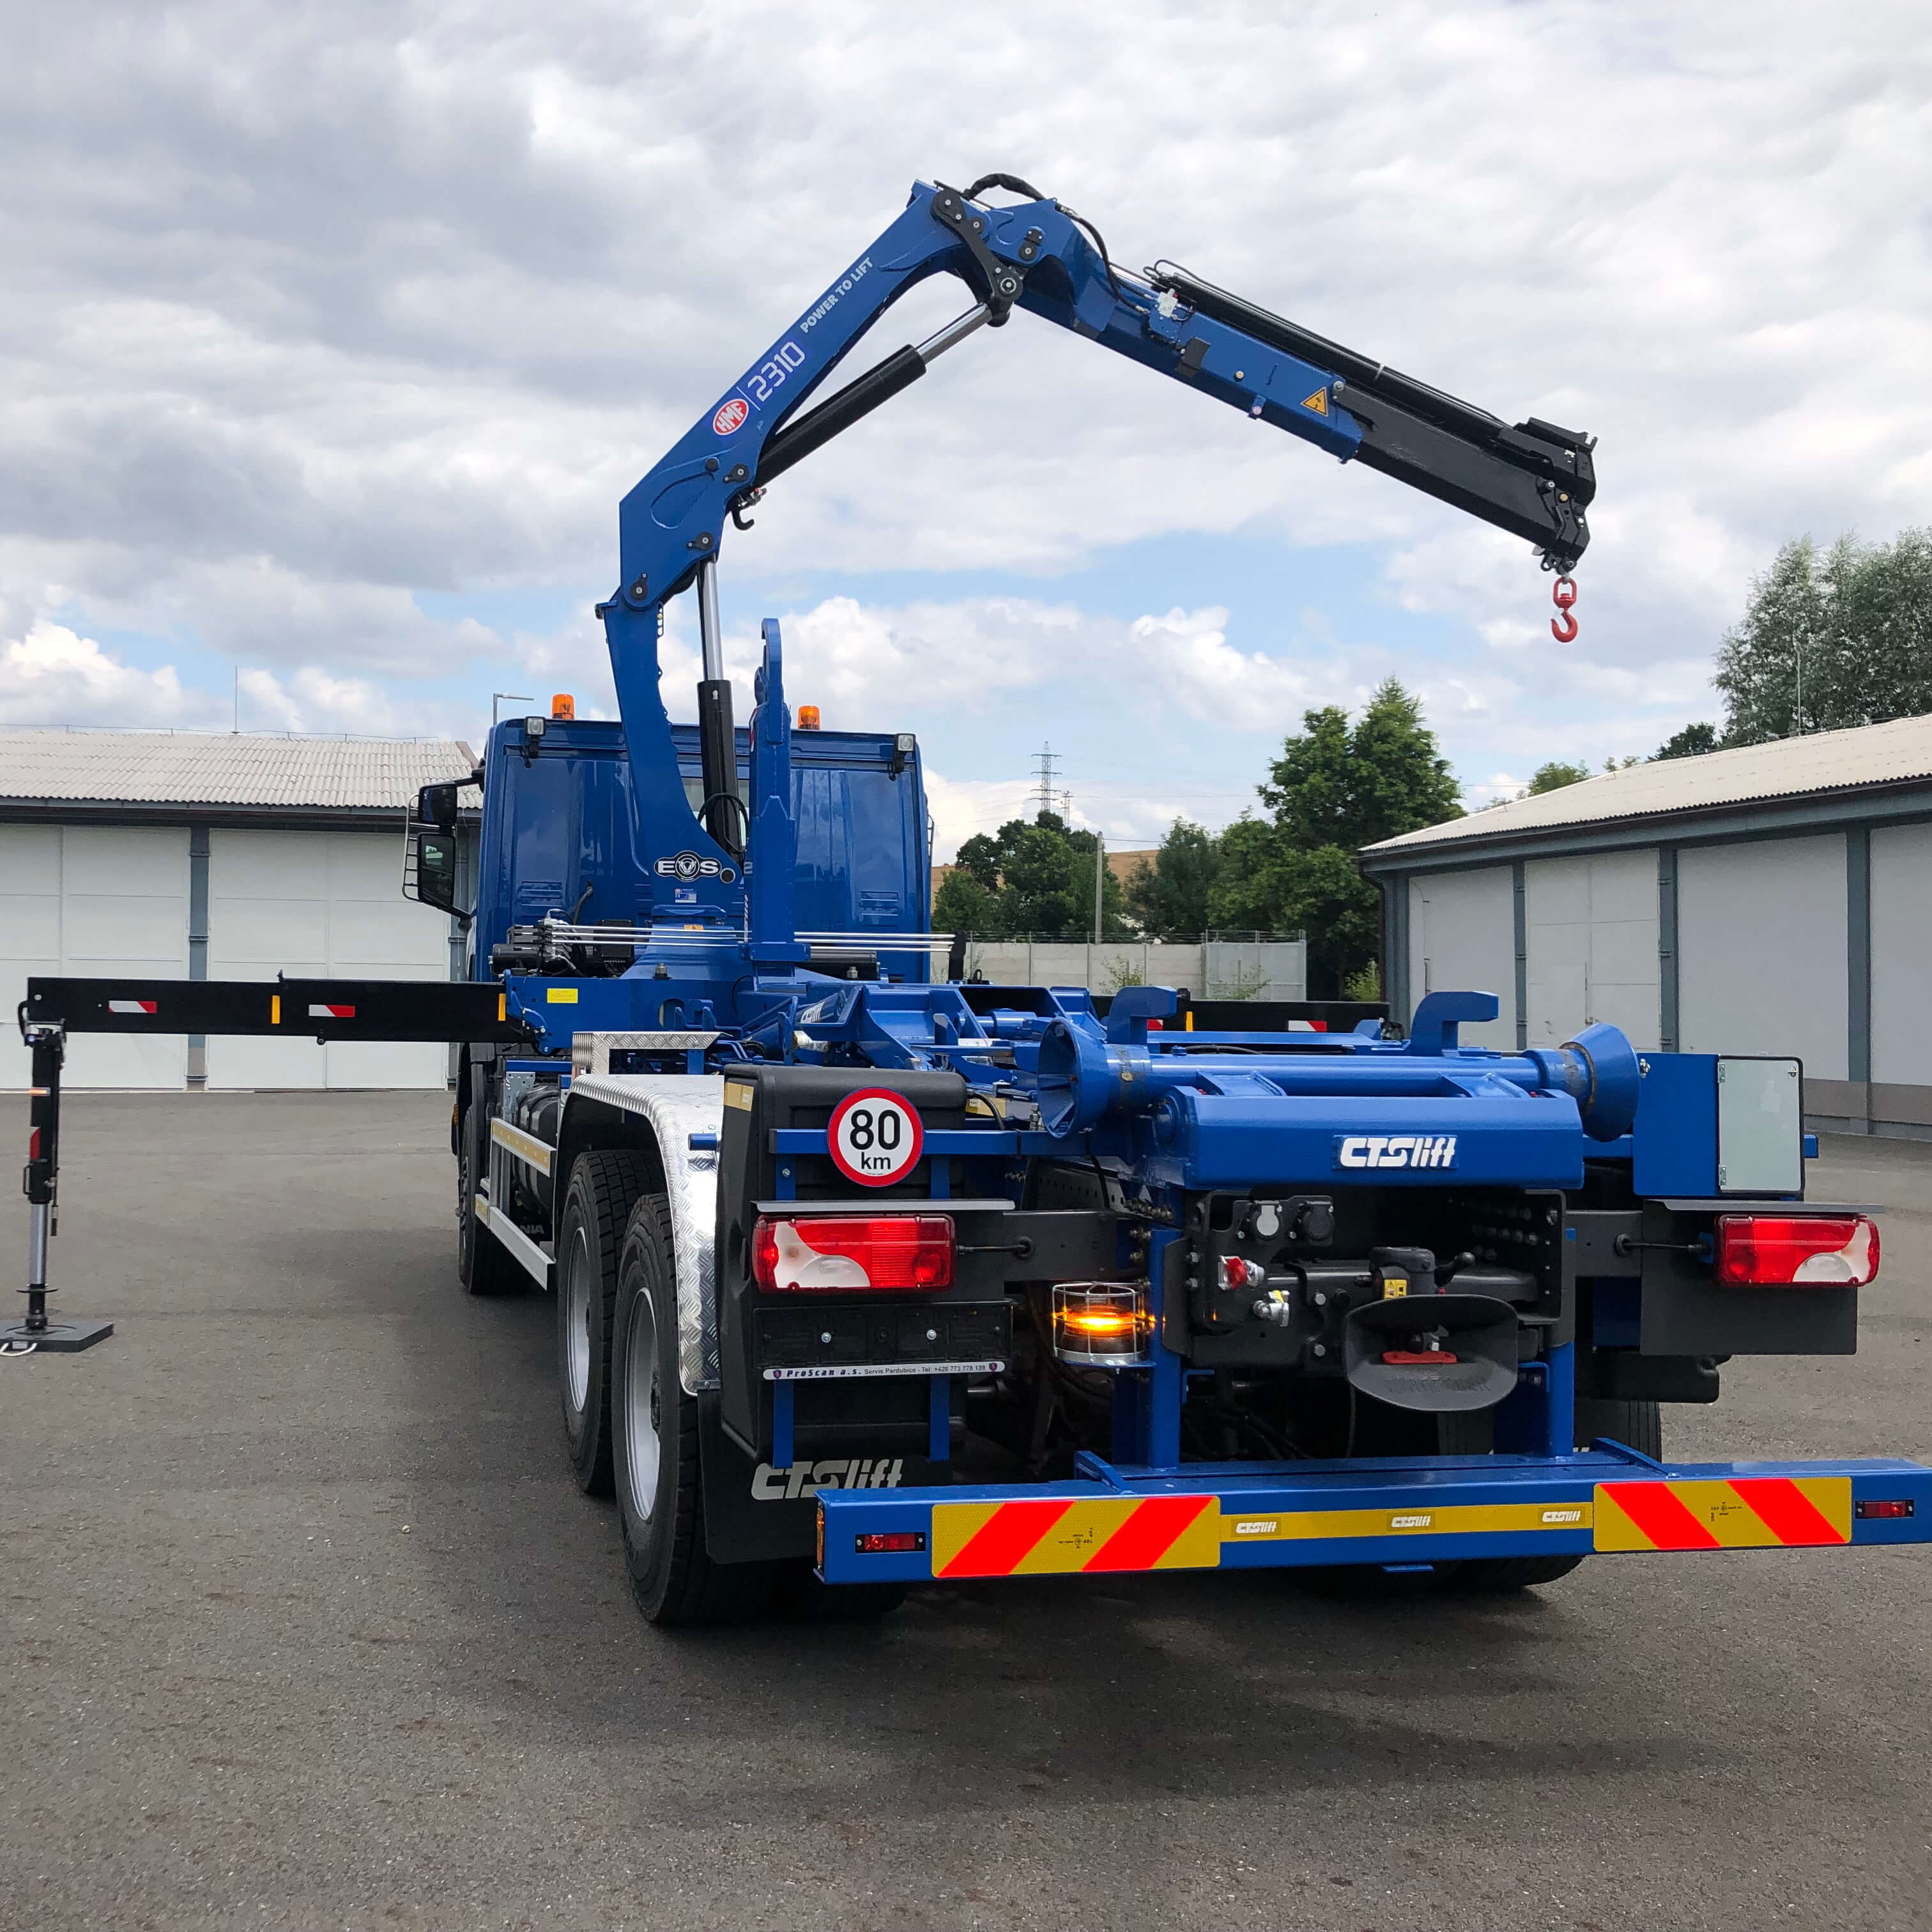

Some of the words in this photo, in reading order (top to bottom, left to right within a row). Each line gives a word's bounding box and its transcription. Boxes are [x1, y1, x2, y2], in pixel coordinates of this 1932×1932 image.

[800, 295, 838, 333] POWER
[836, 279, 852, 296] TO
[850, 257, 873, 282] LIFT
[747, 341, 805, 402] 2310
[716, 402, 744, 432] HMF
[850, 1109, 900, 1150] 80
[861, 1152, 891, 1169] km
[1340, 1138, 1456, 1167] CTSlift
